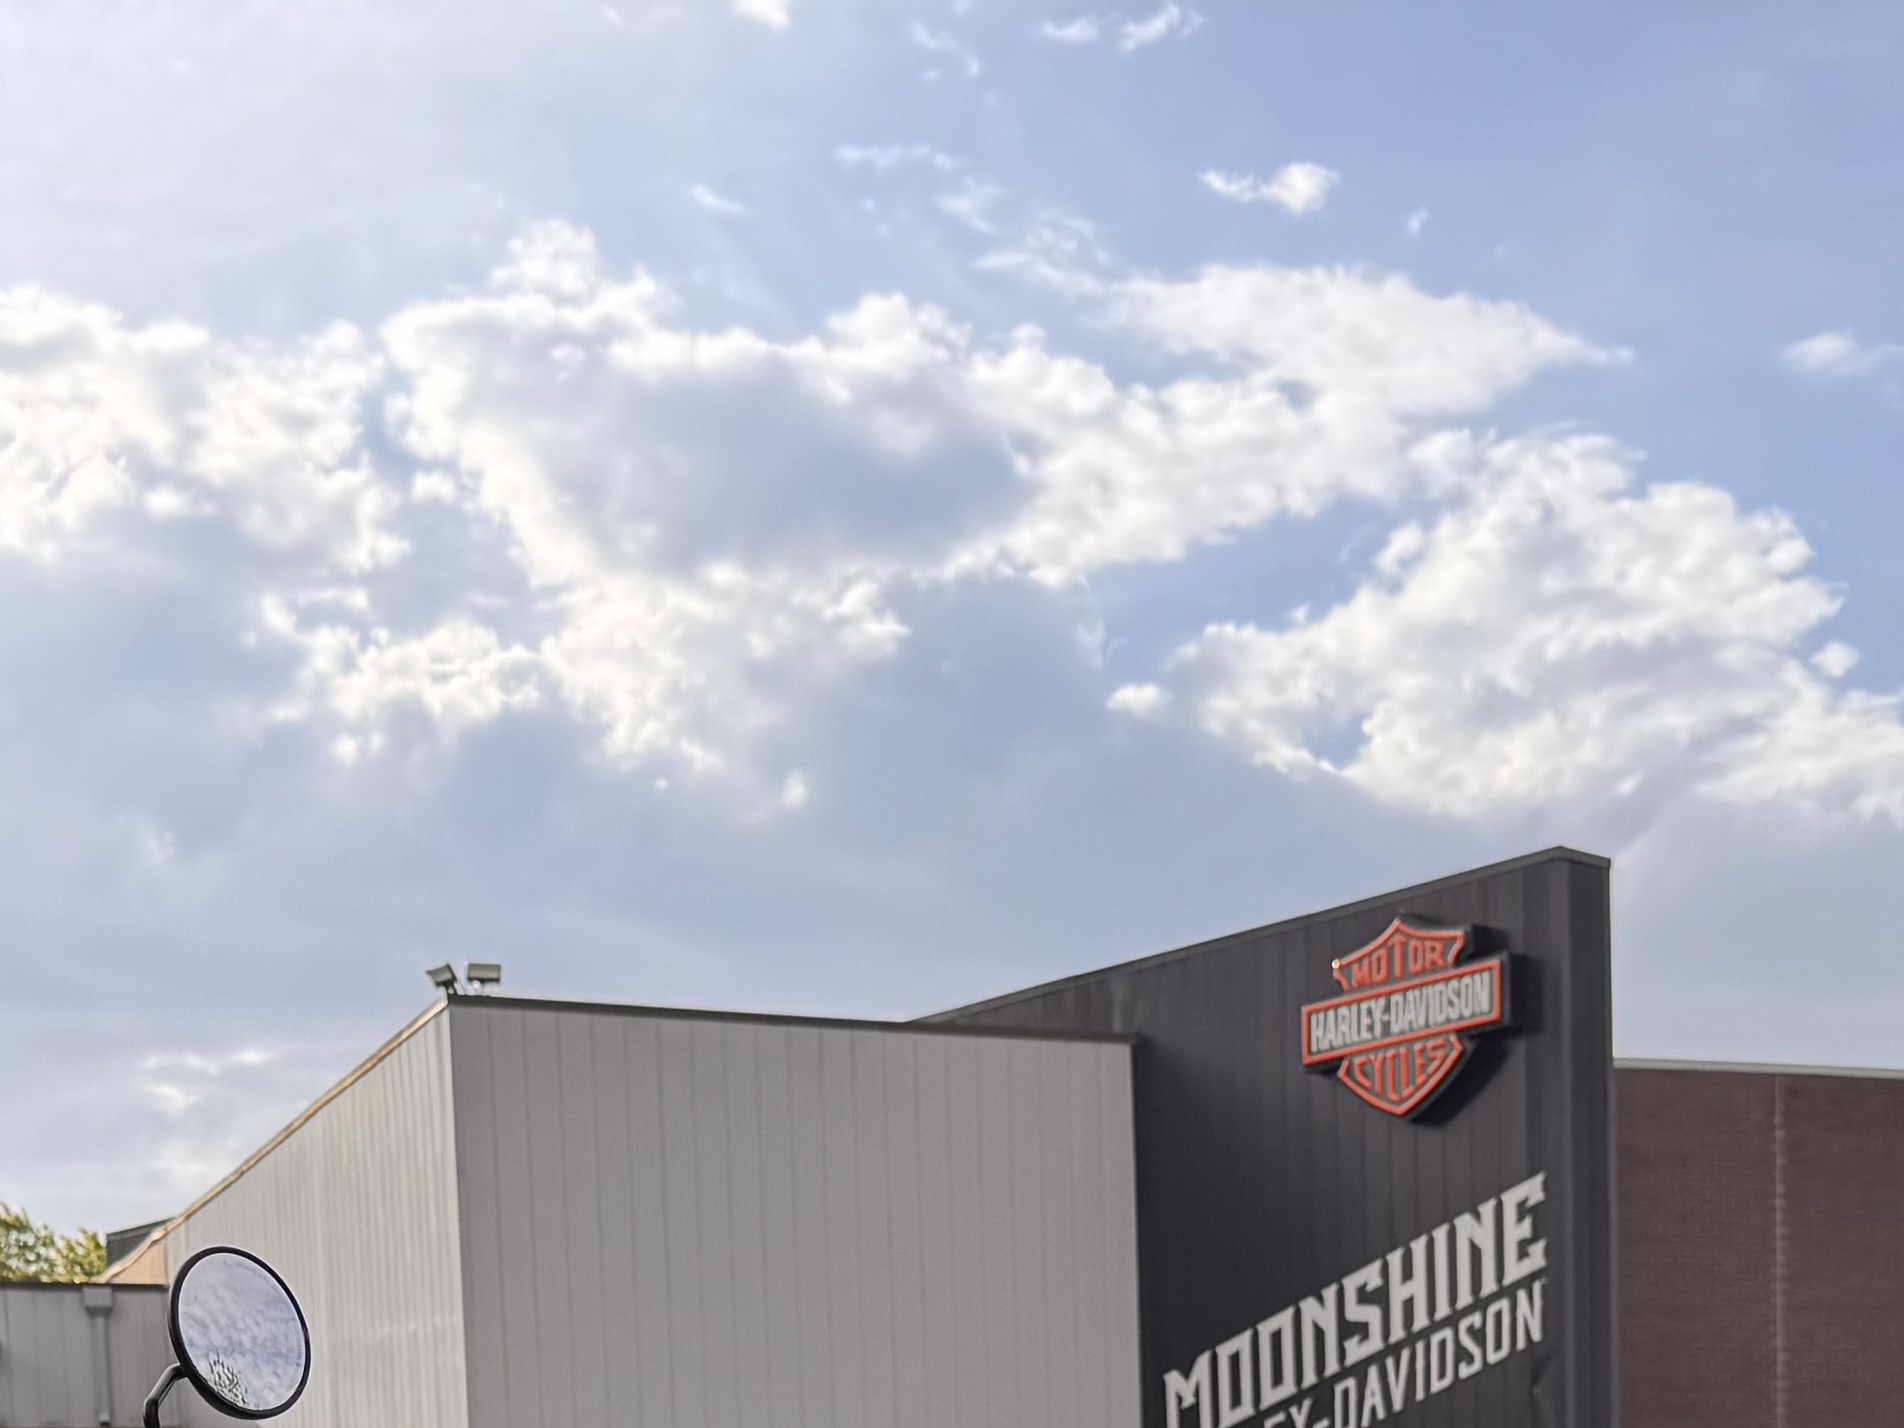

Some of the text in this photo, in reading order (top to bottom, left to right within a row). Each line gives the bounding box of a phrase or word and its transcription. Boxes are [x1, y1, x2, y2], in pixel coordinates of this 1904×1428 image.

[1352, 935, 1446, 988] MOTOR
[1310, 969, 1490, 1053] HARLEY-DAVIDSON
[1354, 1038, 1446, 1101] CYCLES
